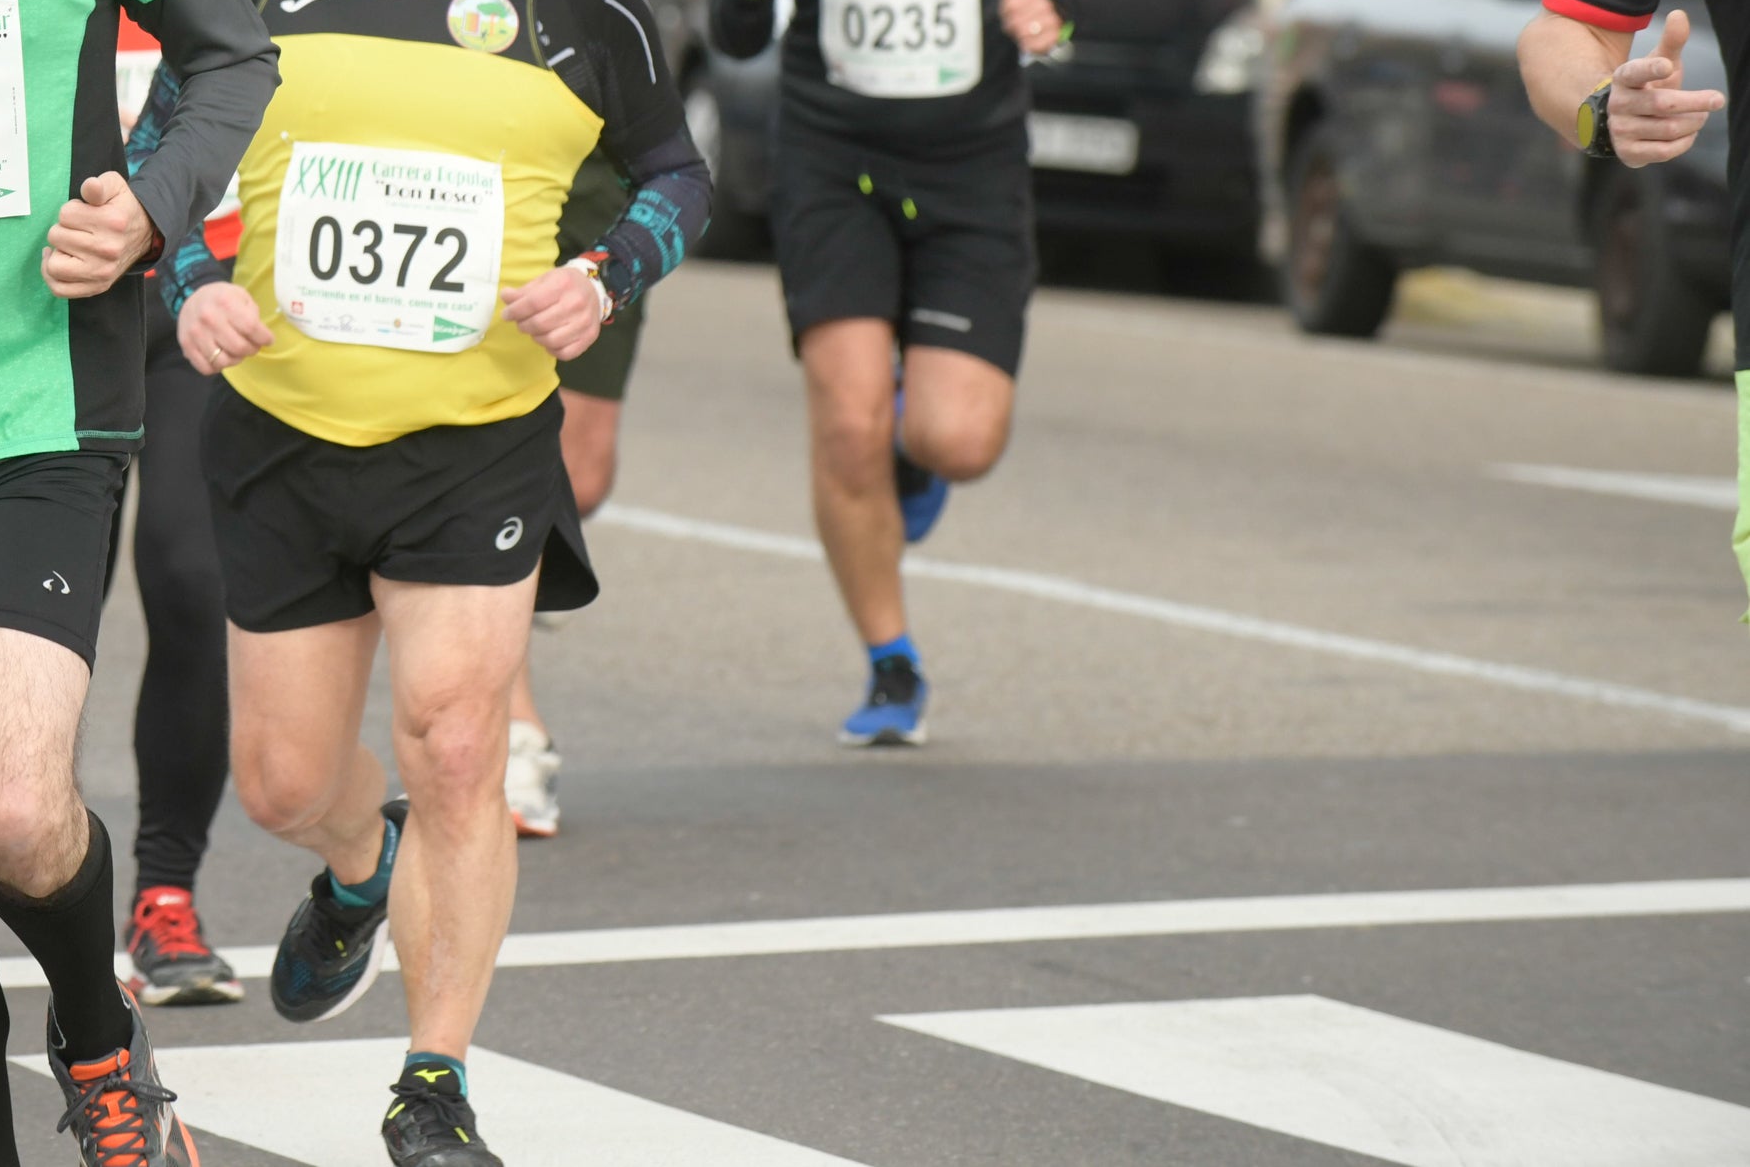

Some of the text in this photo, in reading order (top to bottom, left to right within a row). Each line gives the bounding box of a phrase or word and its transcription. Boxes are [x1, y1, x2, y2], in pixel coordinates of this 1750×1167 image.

[841, 1, 957, 51] 0235
[290, 155, 363, 201] XXIII
[372, 160, 494, 189] Carrera Popular
[309, 215, 468, 293] 0372
[408, 298, 434, 309] como
